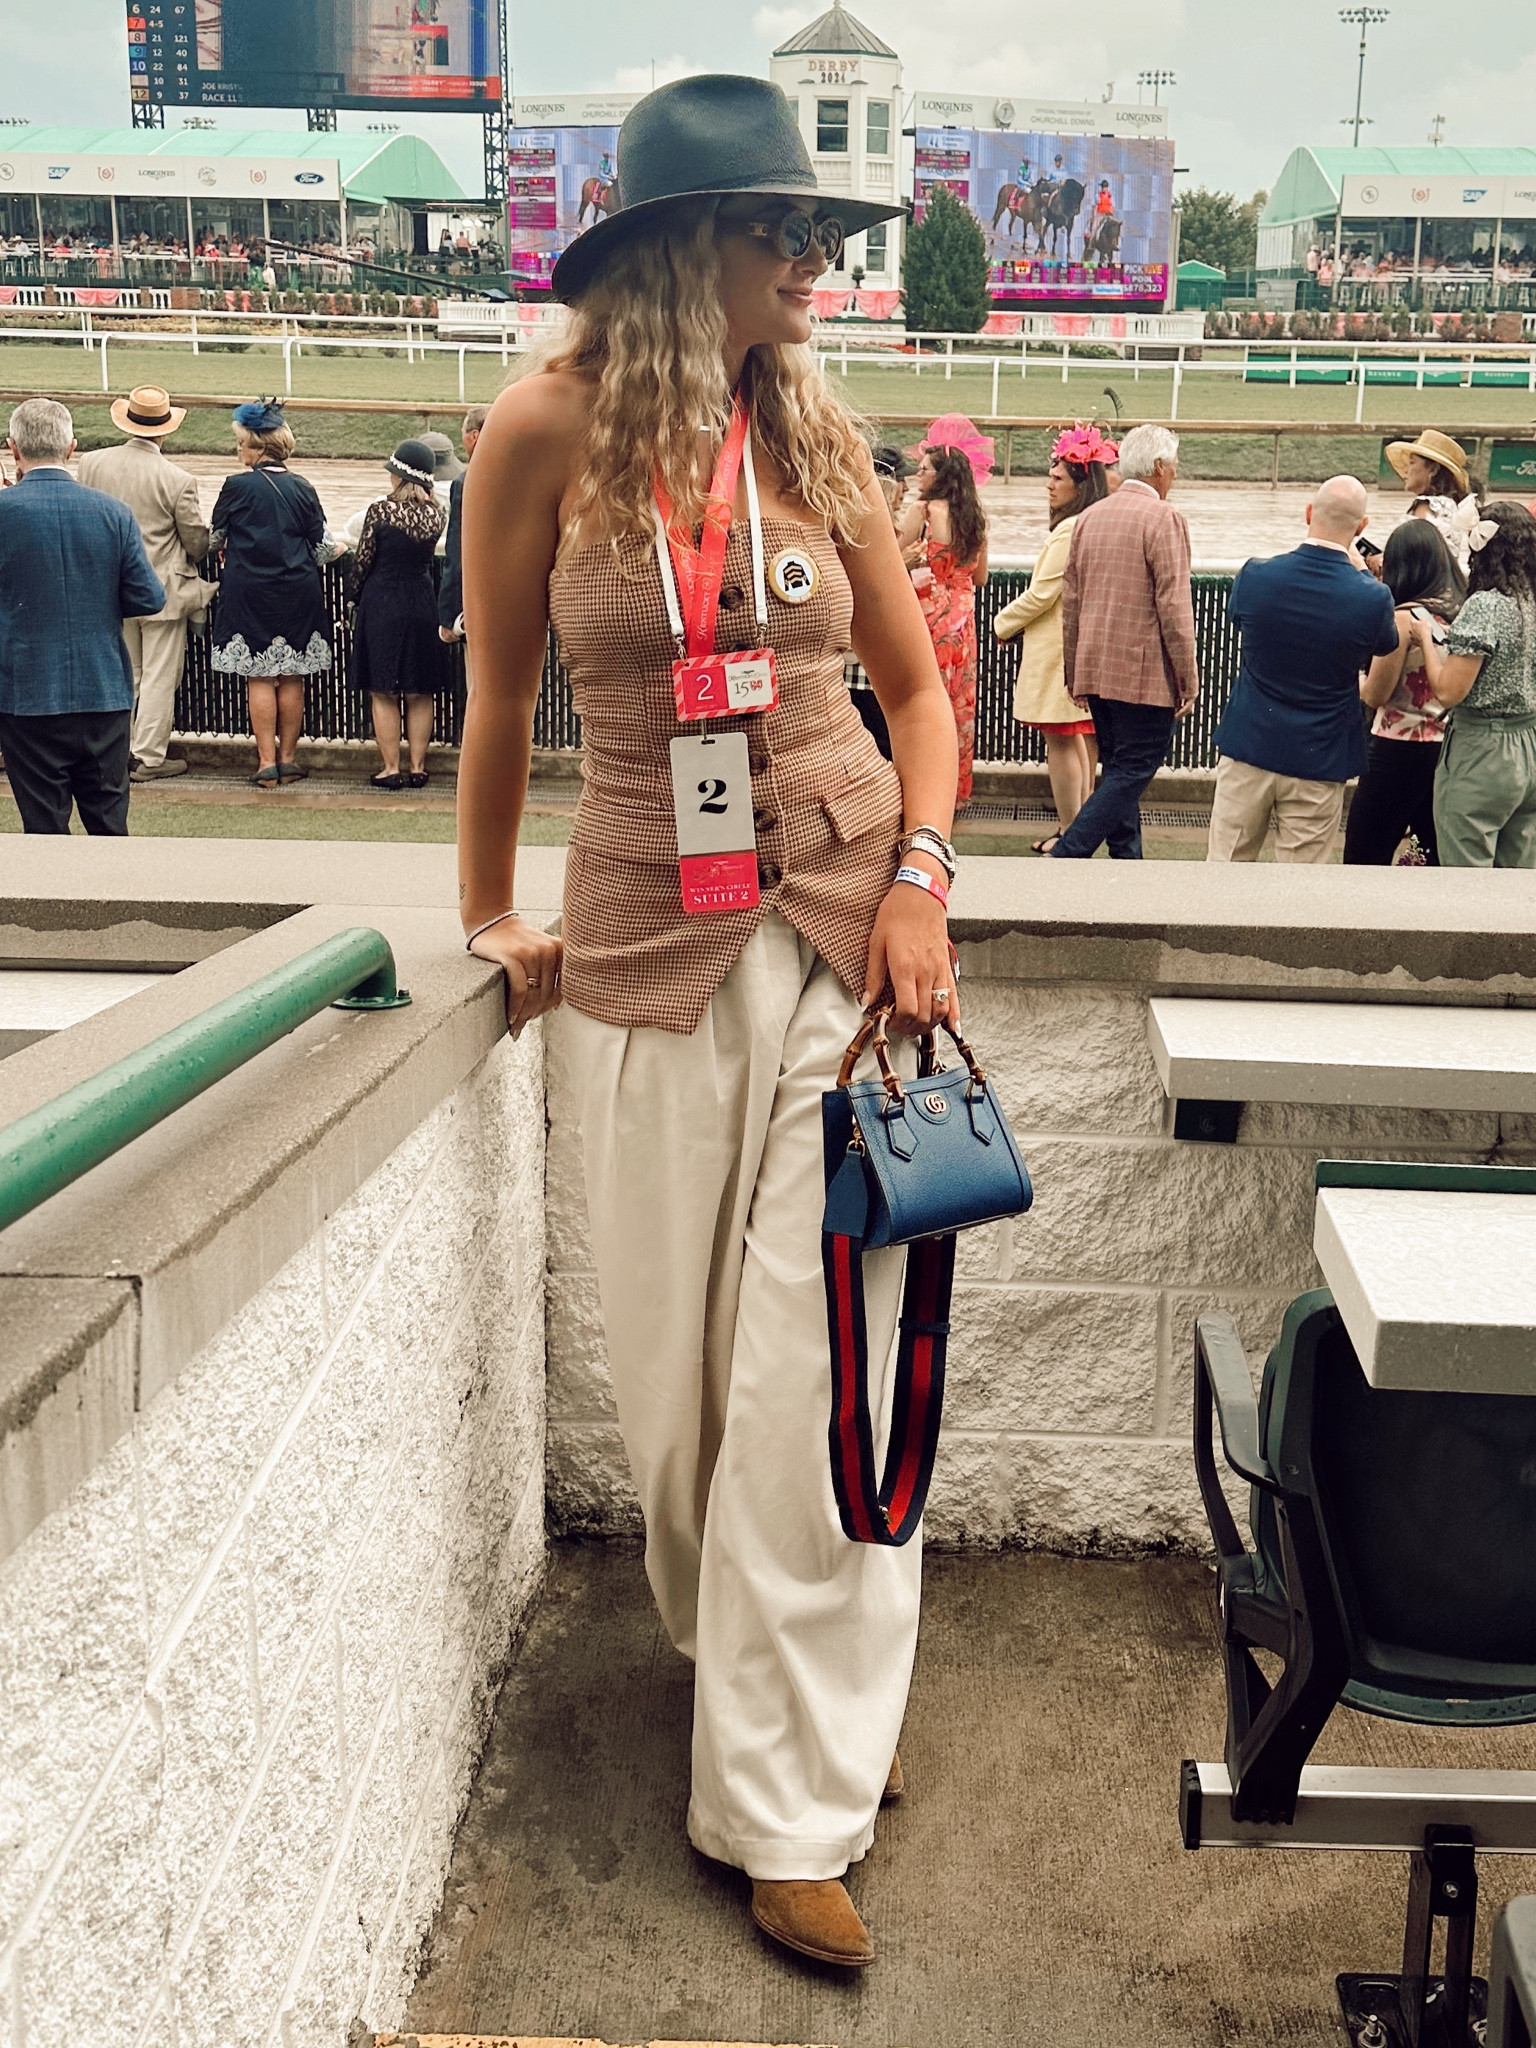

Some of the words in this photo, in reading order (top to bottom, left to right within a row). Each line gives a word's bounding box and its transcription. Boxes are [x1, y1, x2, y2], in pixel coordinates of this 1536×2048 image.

[132, 3, 140, 13] 6
[149, 6, 161, 14] 24
[174, 6, 185, 14] 67
[134, 19, 140, 27] 7
[134, 33, 141, 42] 8
[151, 34, 162, 42] 21
[174, 35, 188, 43] 121
[134, 47, 142, 56] 9
[152, 49, 162, 57] 12
[176, 49, 187, 57] 40
[132, 61, 146, 71] 10
[152, 63, 163, 71] 22
[808, 60, 859, 72] DERBY
[154, 77, 164, 85] 10
[821, 72, 846, 84] 2024
[134, 91, 146, 99] 12
[156, 91, 163, 99] 9
[178, 92, 189, 100] 37
[201, 93, 225, 102] RACE
[521, 103, 565, 113] LONGINES
[922, 100, 973, 113] LONGINES
[1070, 118, 1095, 126] DOWNS
[1115, 111, 1162, 123] LONGINES
[49, 167, 68, 178] SAP
[138, 169, 176, 177] LONGINES
[1463, 190, 1484, 202] SAP
[695, 673, 714, 701] 2
[697, 778, 729, 815] 2
[693, 891, 738, 905] SUITE
[740, 890, 749, 900] 2
